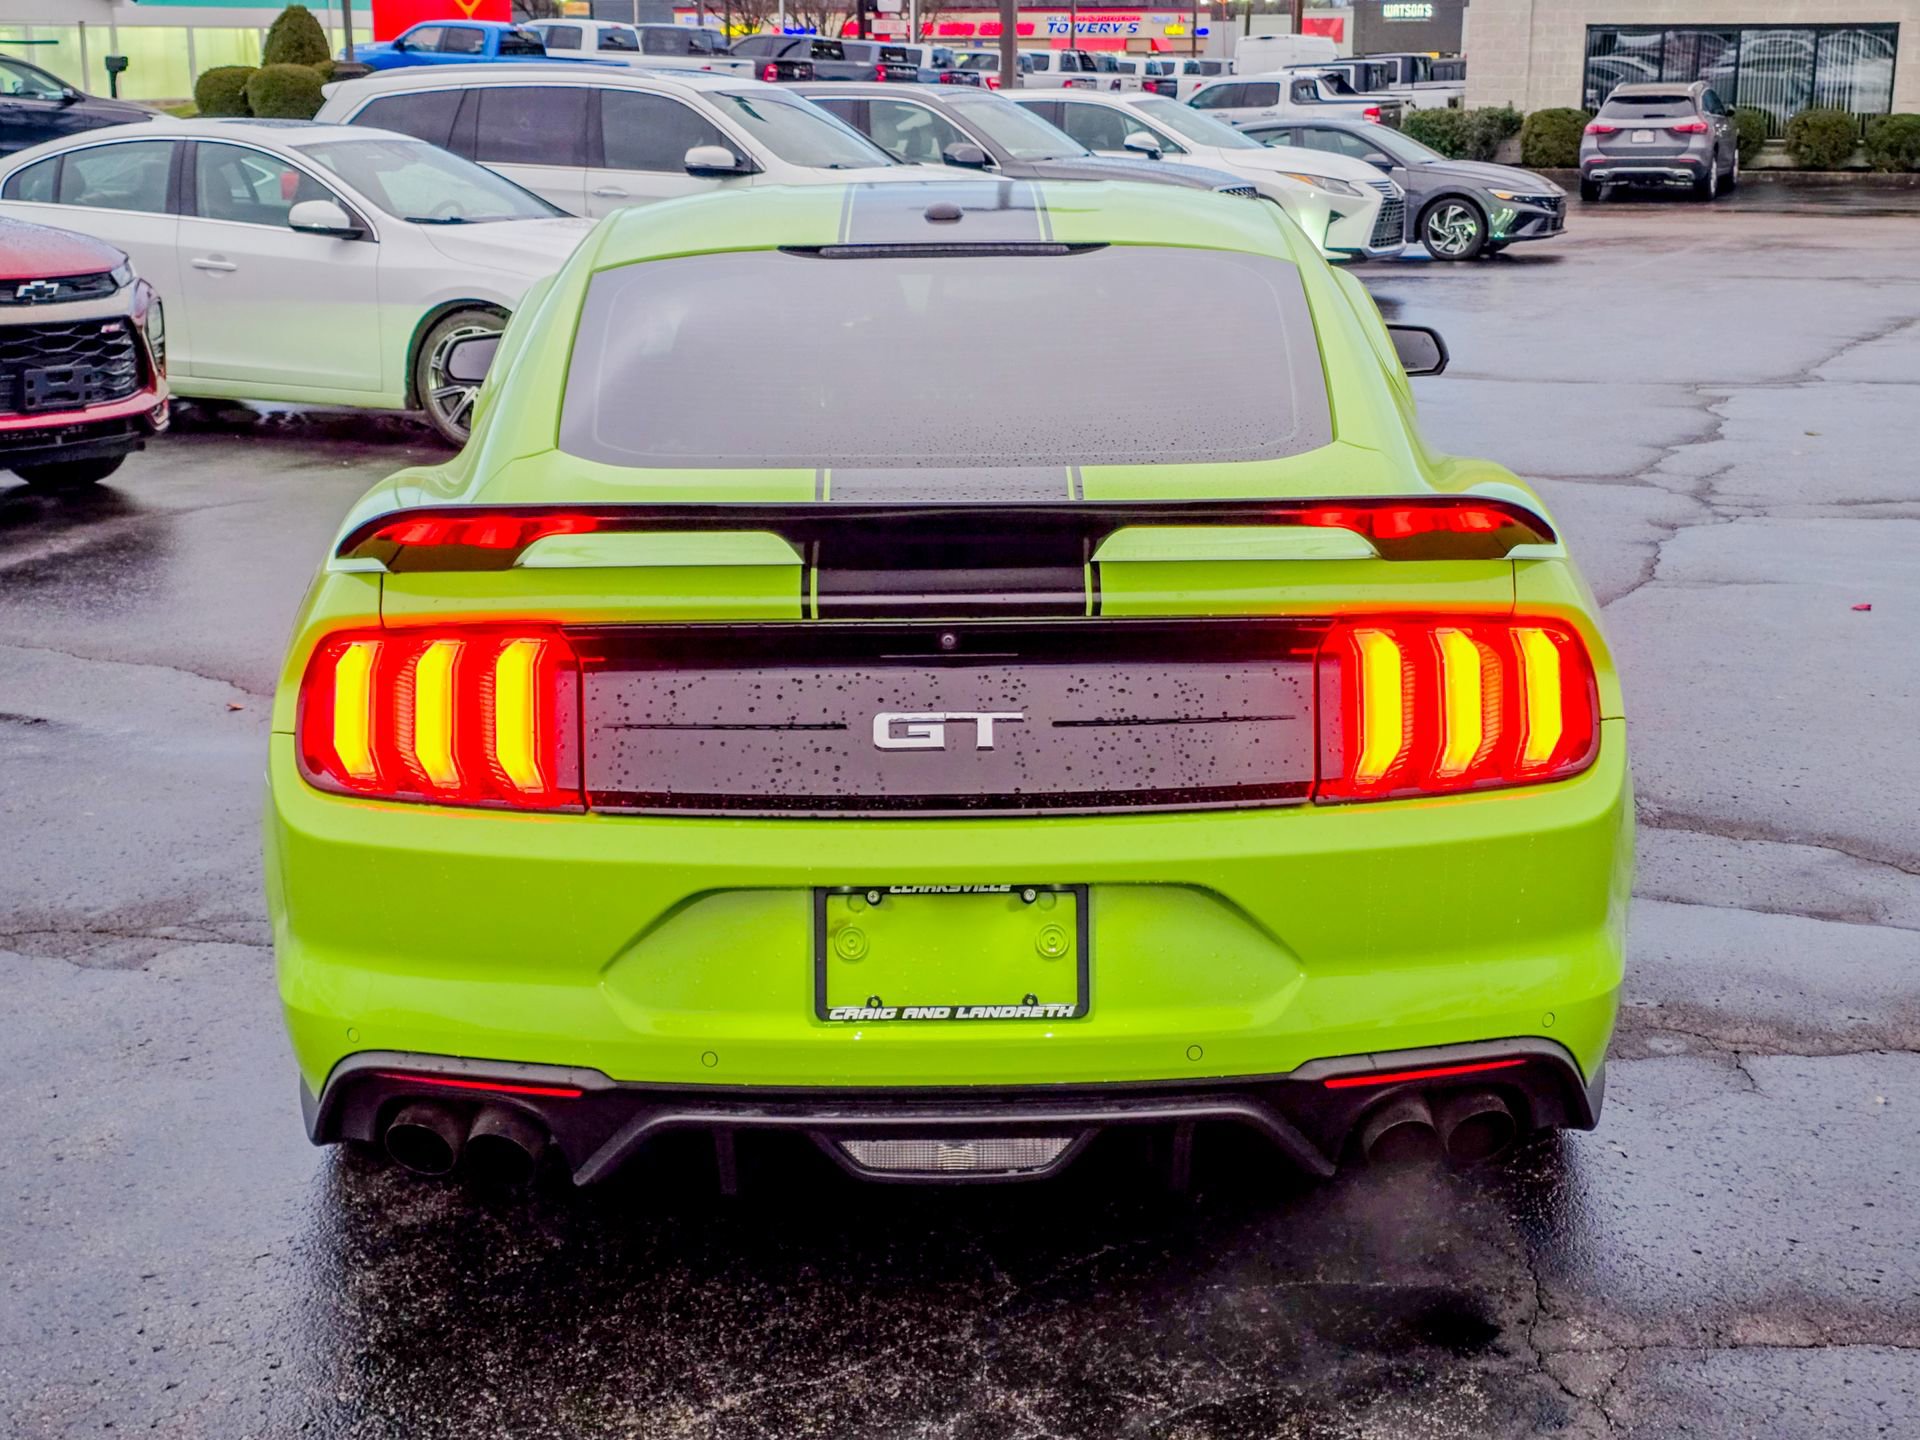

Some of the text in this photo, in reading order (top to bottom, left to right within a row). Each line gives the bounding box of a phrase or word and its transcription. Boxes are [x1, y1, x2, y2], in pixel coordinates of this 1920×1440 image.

[873, 712, 1025, 752] GT
[828, 1005, 1076, 1020] CRAIG AND LANDRETH
